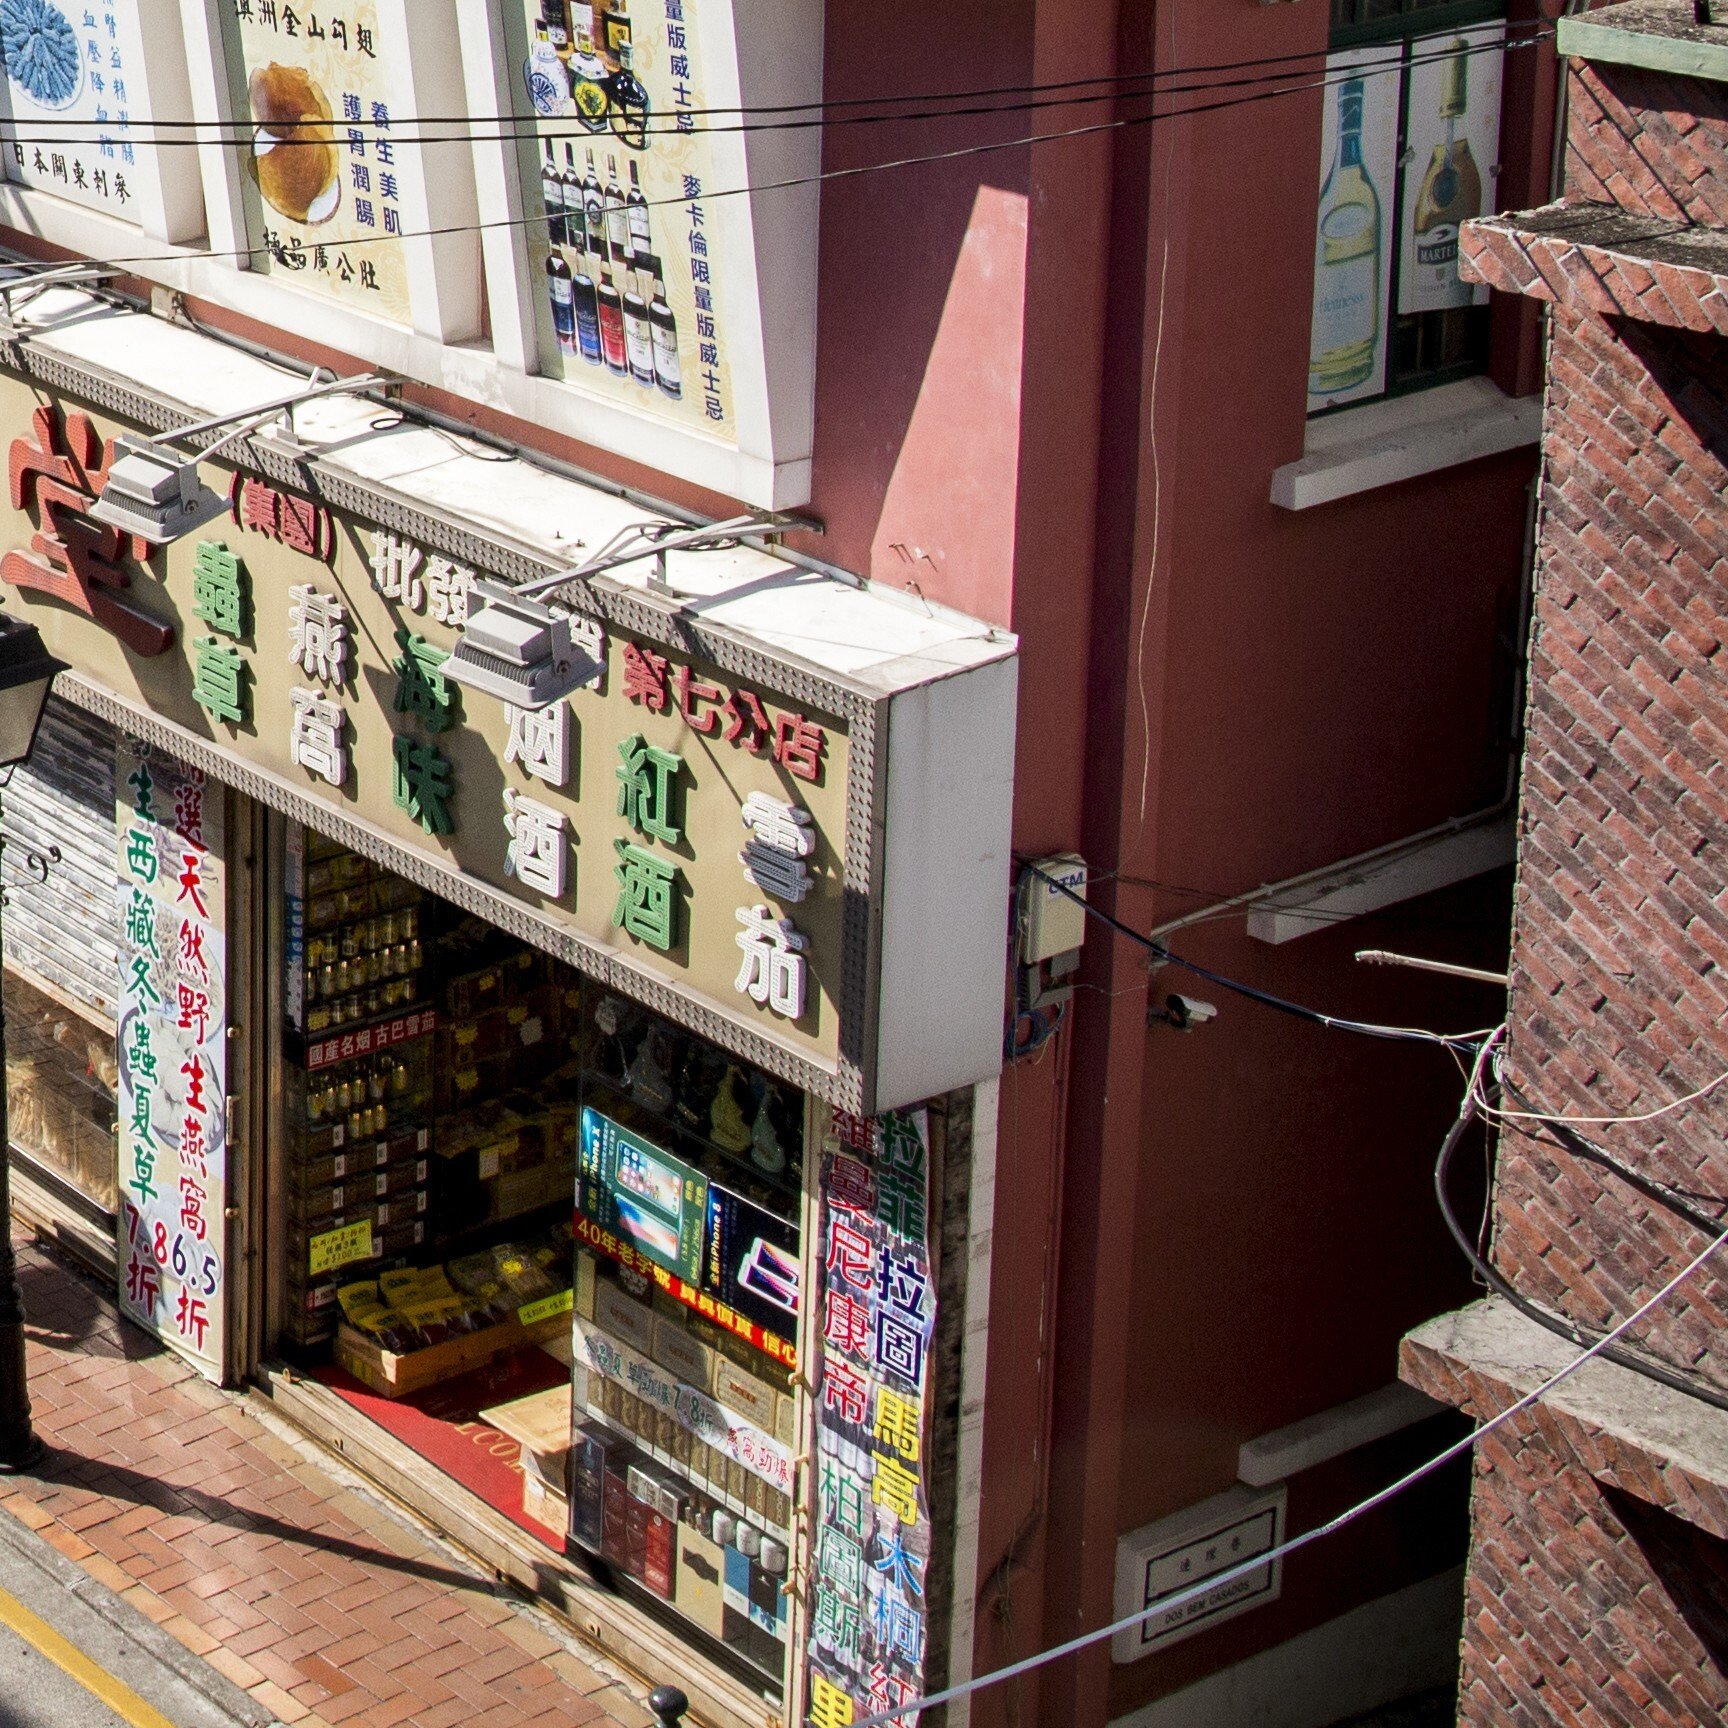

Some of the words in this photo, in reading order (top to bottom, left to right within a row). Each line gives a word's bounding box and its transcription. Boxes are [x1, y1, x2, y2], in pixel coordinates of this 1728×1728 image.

[341, 92, 376, 235] 護胃潤腸
[370, 100, 403, 237] 養生美肌
[681, 173, 725, 423] 麥卡倫限量版威士忌
[228, 468, 334, 564] (集團)
[192, 539, 245, 726] 蟲草
[287, 582, 347, 787] 燕窩
[392, 628, 455, 837] 海味
[619, 639, 825, 782] 第七分店
[612, 731, 687, 952] 紅酒
[734, 790, 817, 1021] 雪茄
[308, 1031, 372, 1067] 國產名烟
[374, 1010, 437, 1047] 古巴雪茄
[877, 1110, 928, 1243] 拉菲
[876, 1245, 928, 1387] 拉圖
[871, 1387, 920, 1527] 馬高
[818, 1459, 863, 1660] 柏圖斯
[875, 1532, 924, 1664] 木桐
